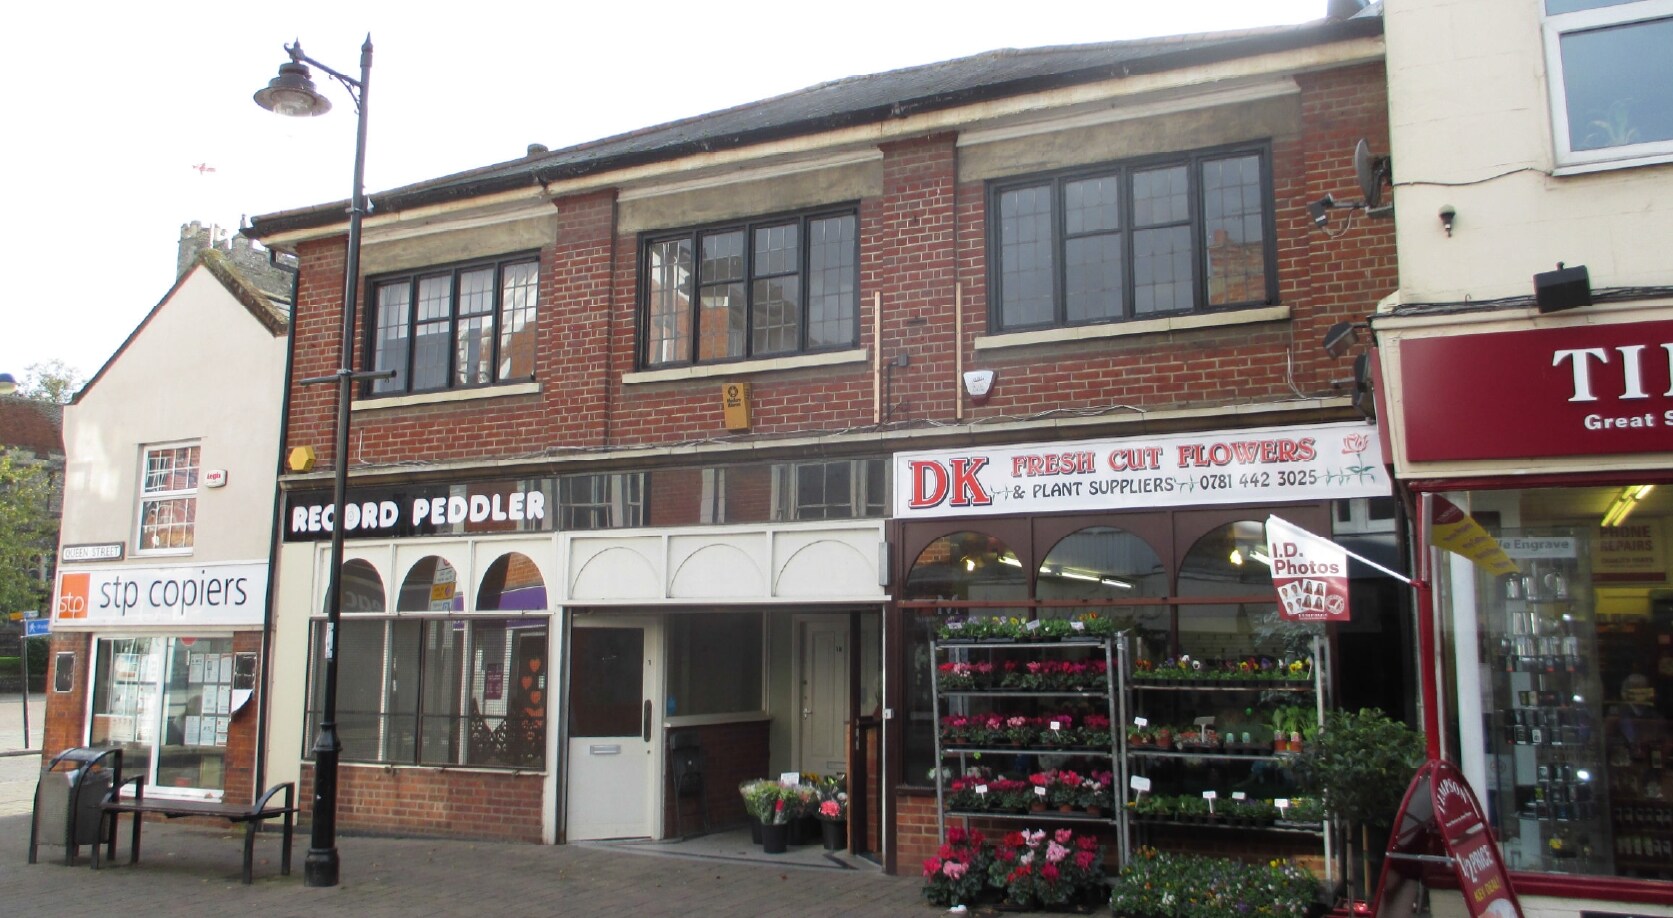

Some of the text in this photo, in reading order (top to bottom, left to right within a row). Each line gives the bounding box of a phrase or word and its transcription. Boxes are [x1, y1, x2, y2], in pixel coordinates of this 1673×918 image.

[1584, 413, 1654, 430] Great
[1011, 437, 1317, 477] FRESH CUT FLOWERS
[908, 457, 993, 509] DK
[1012, 469, 1317, 499] & PLANT SUPPLIERS 0781 442 3025
[292, 490, 545, 533] RECORD PEDDLER
[65, 546, 119, 558] QUEEN STREET
[1272, 542, 1304, 559] I.D.
[1514, 540, 1569, 551] Engrave
[1274, 559, 1339, 575] Photos
[59, 591, 85, 619] stp
[100, 569, 248, 616] stp copiers
